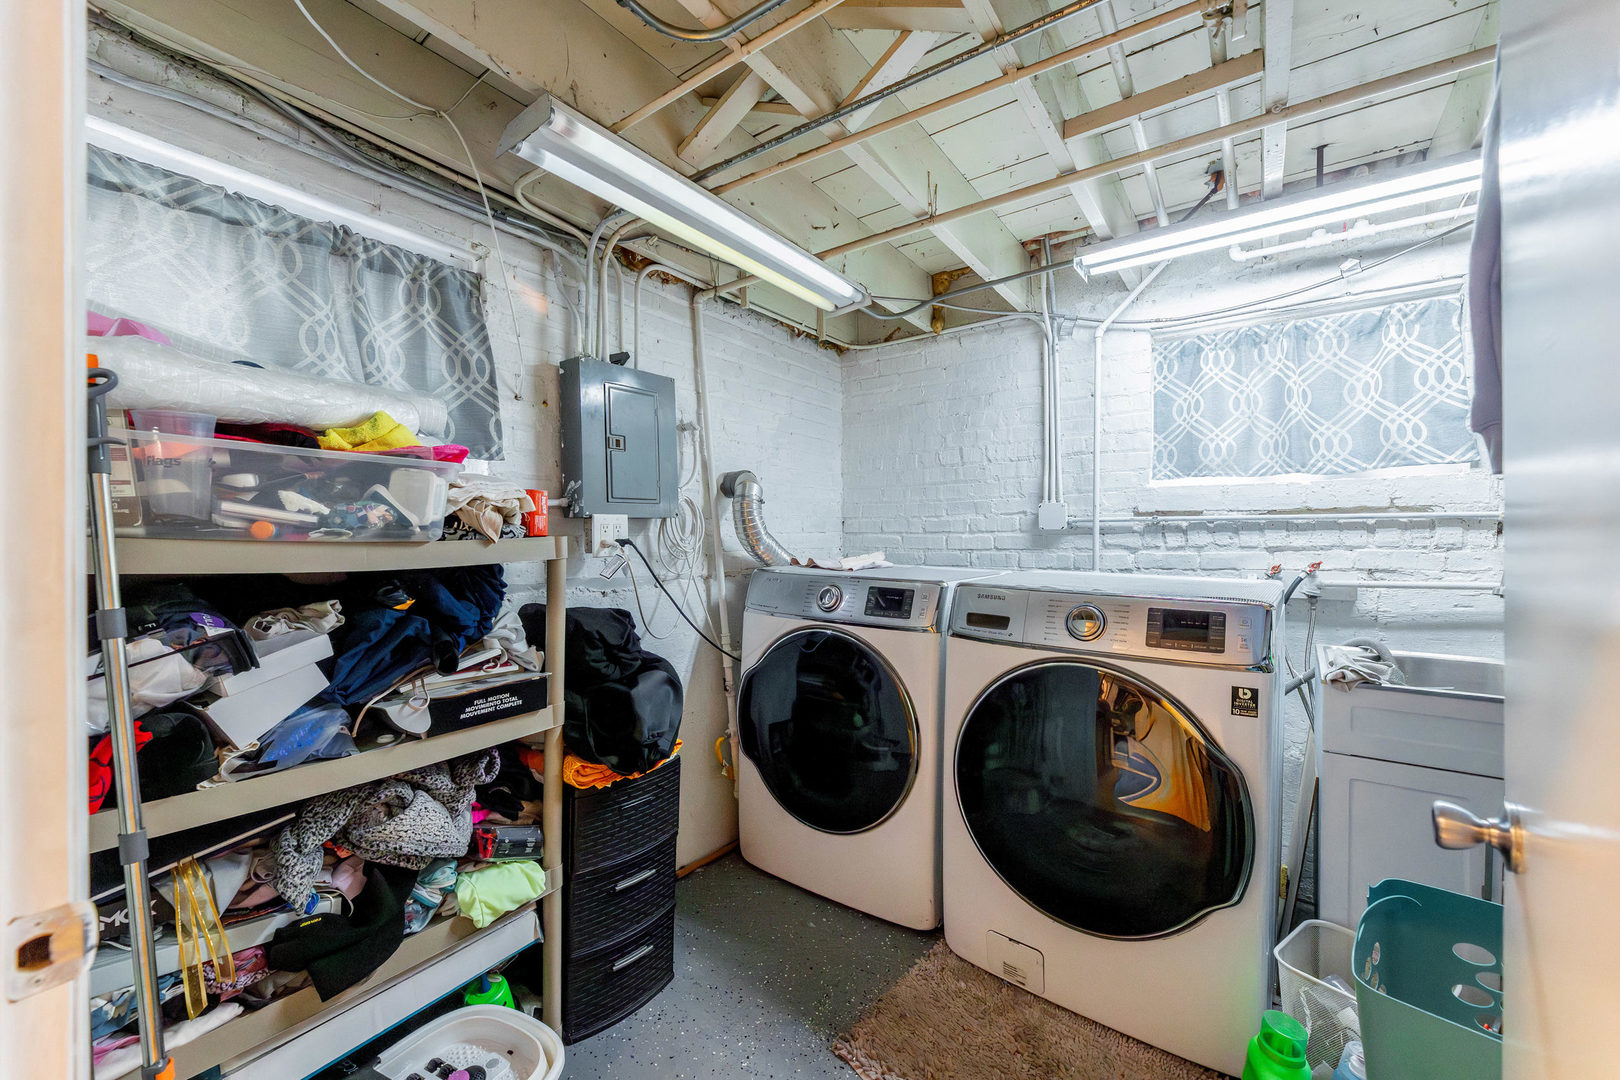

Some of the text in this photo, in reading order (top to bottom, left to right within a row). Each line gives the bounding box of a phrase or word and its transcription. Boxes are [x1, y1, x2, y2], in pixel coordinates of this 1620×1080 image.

[977, 593, 1006, 601] SAMSUNG
[488, 693, 510, 701] MOTION
[460, 699, 523, 719] MOUVEMENT COMPLETE
